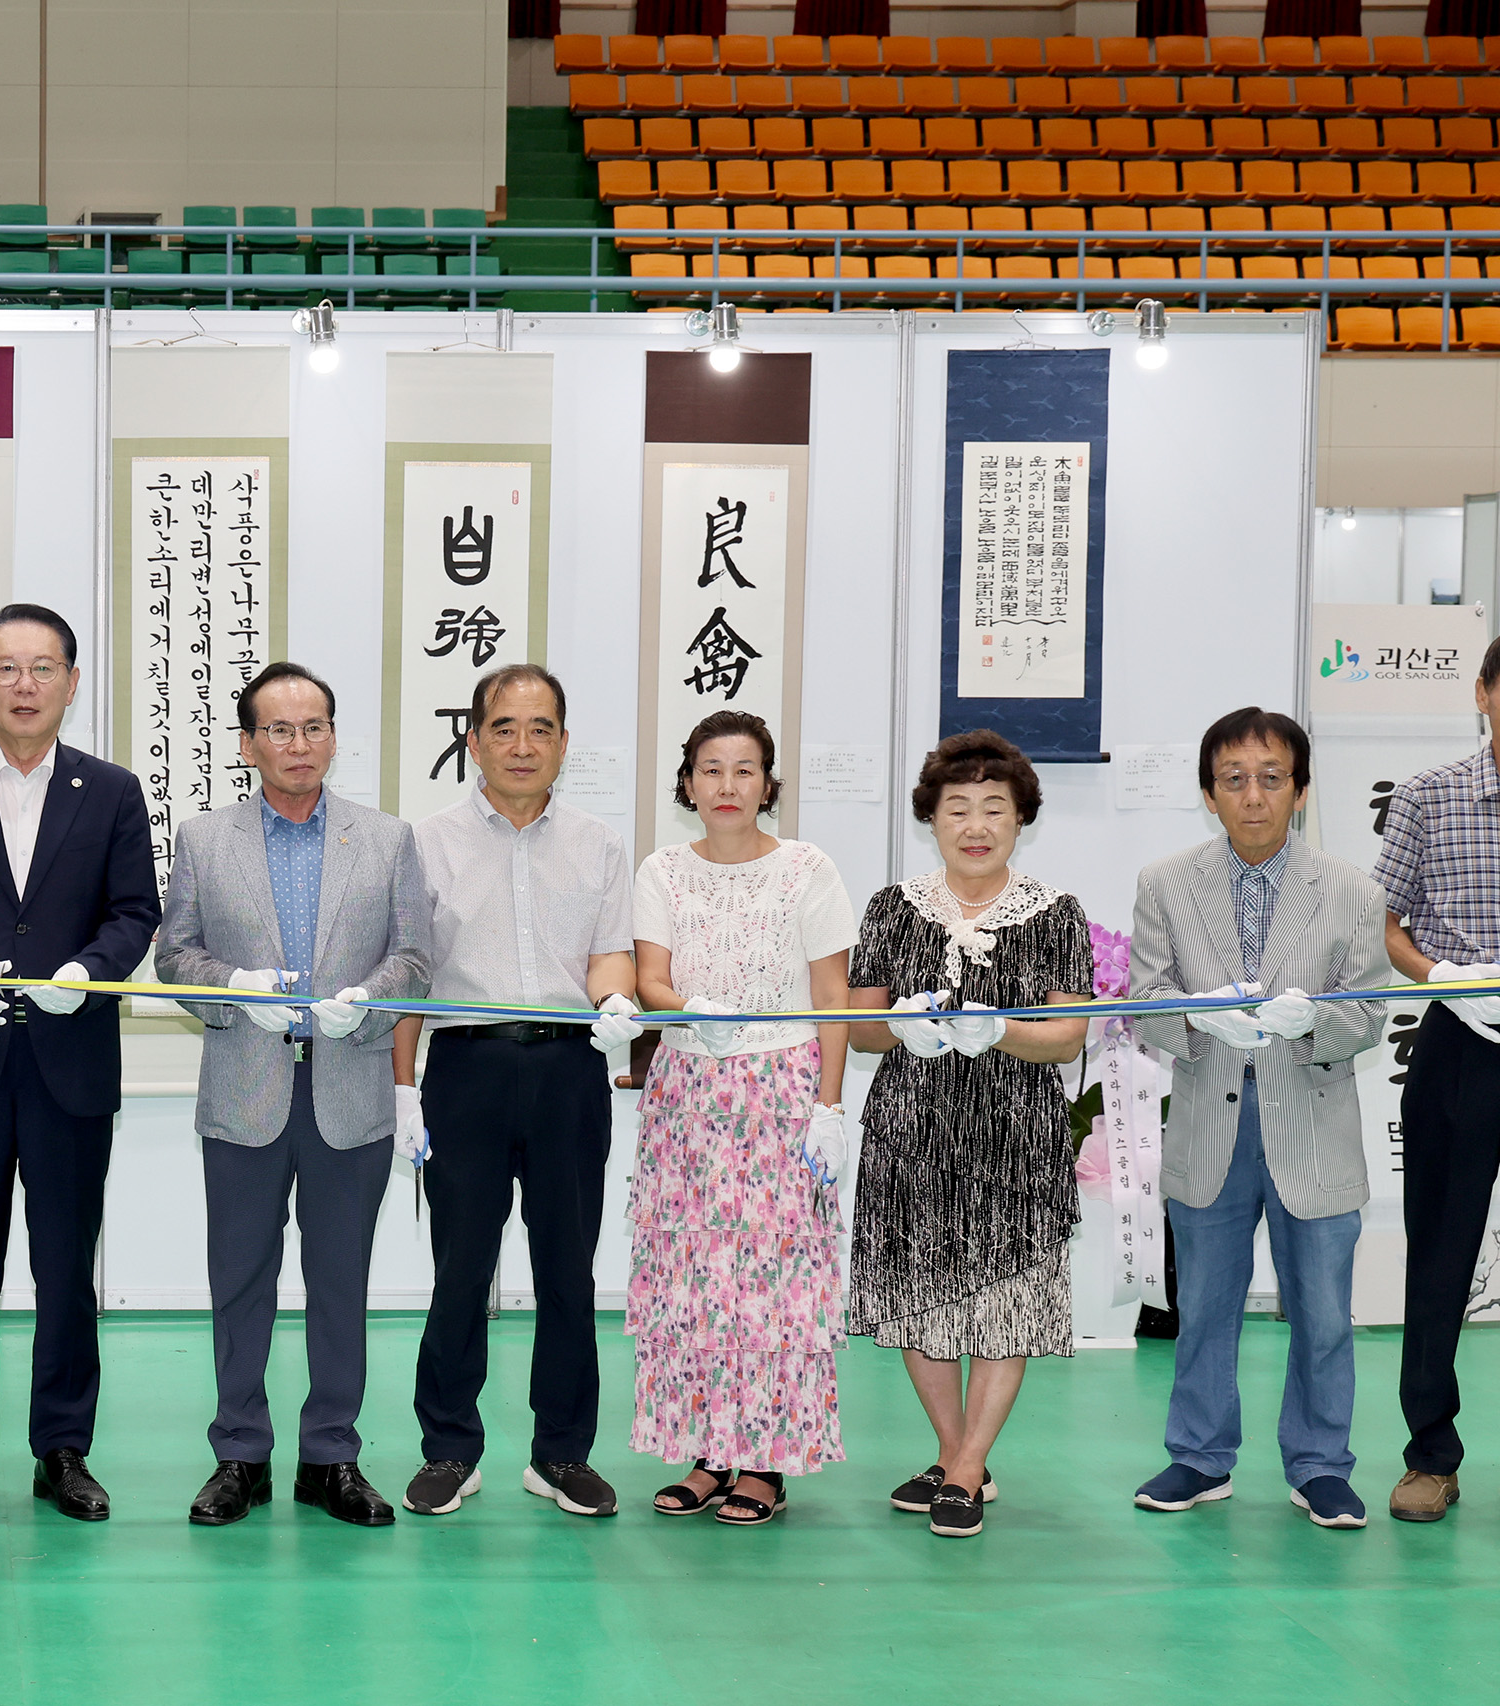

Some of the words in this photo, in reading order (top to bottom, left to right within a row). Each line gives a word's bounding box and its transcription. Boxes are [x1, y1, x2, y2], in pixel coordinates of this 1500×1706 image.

[1375, 647, 1460, 671] 괴산군
[1375, 671, 1402, 680] GOE
[1405, 671, 1430, 680] SAN
[1432, 671, 1460, 680] GUN
[1121, 1213, 1135, 1284] 회원일동
